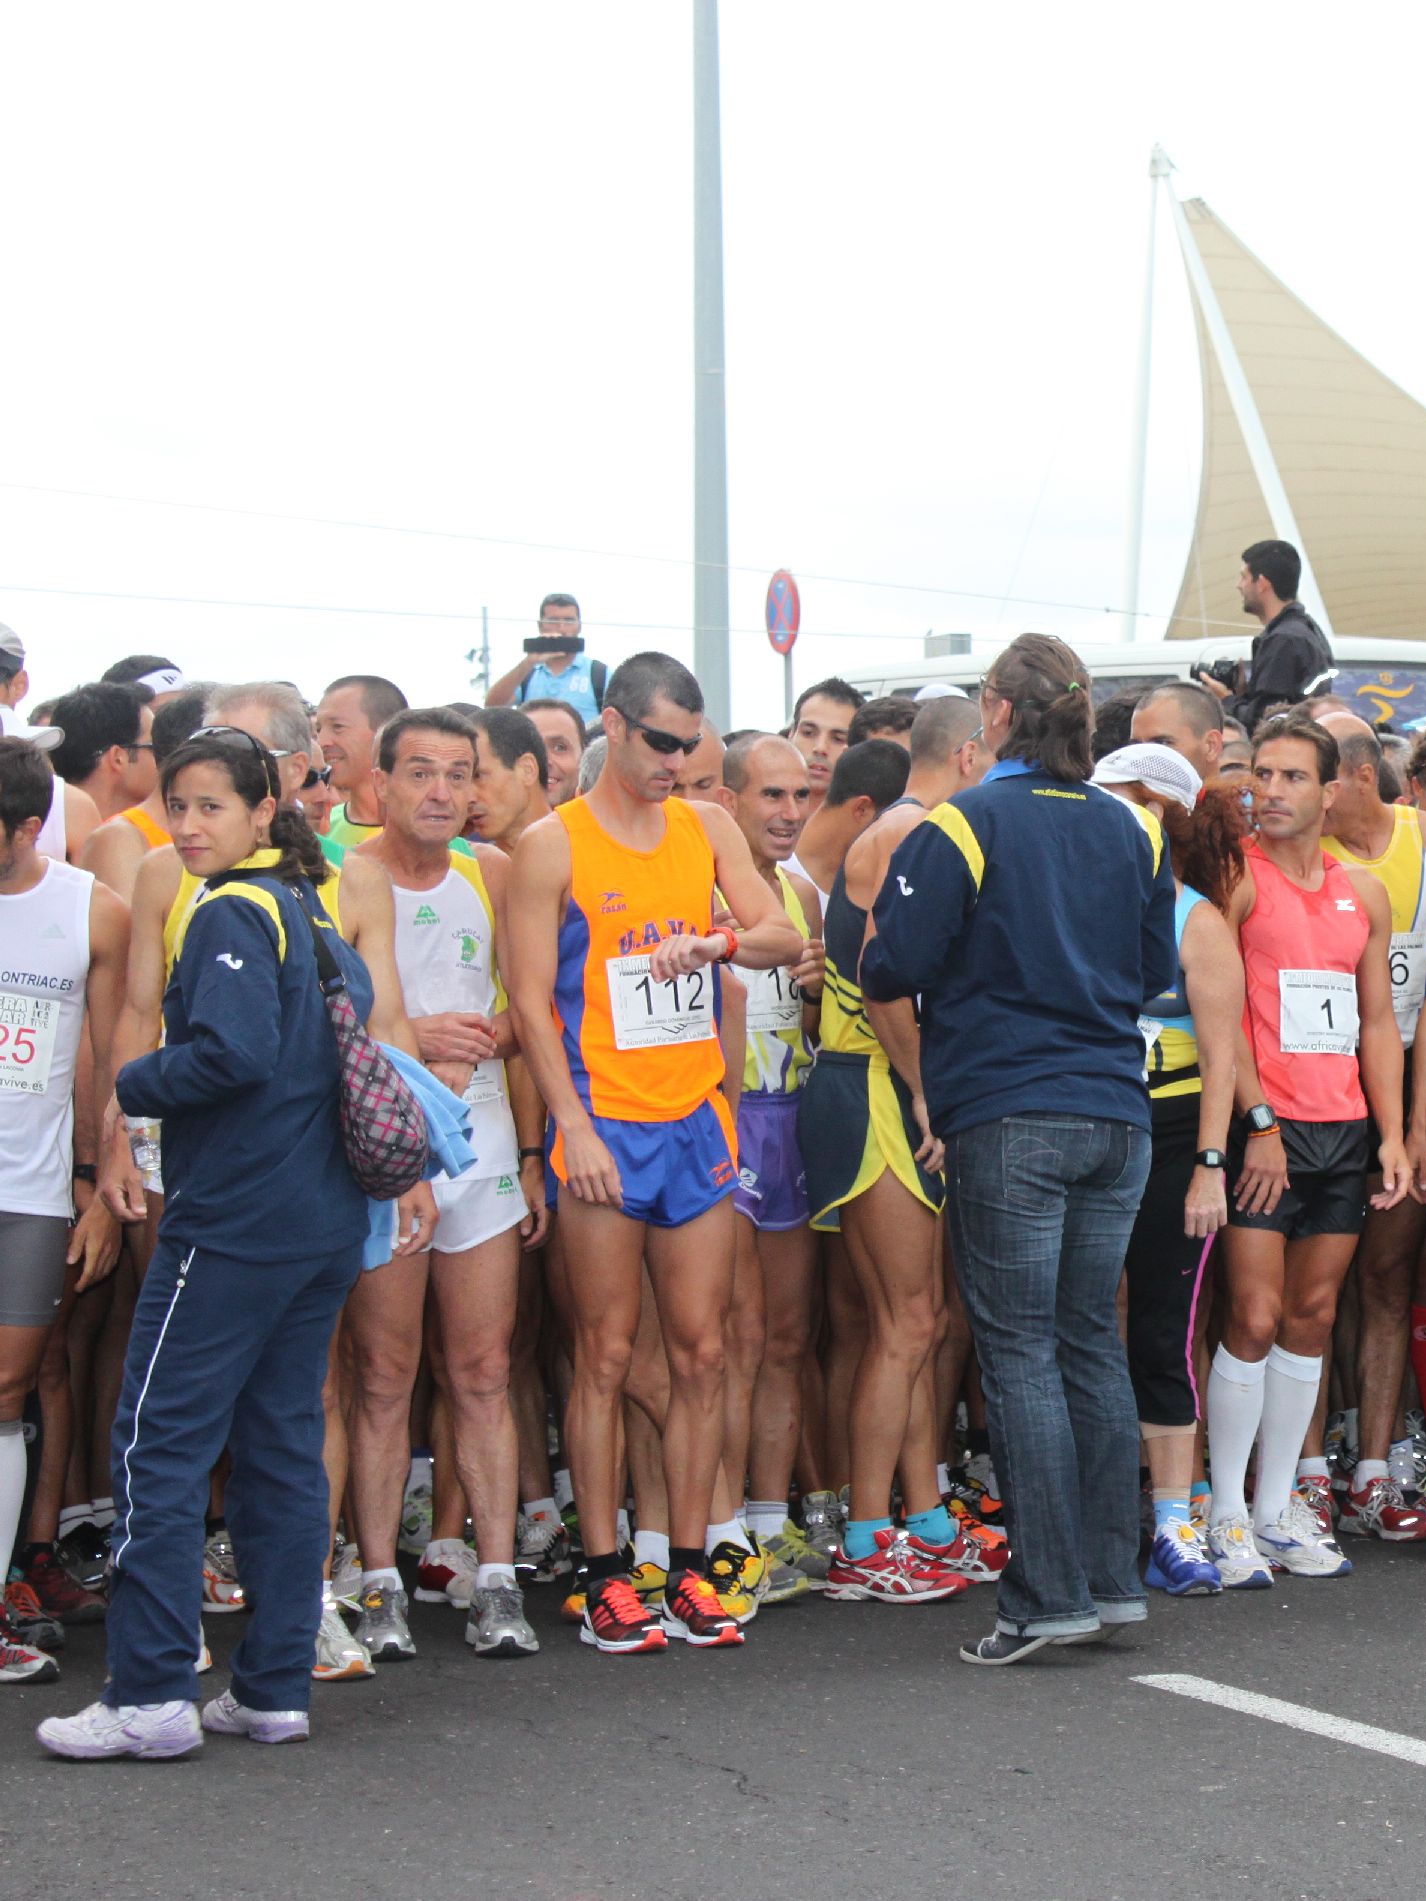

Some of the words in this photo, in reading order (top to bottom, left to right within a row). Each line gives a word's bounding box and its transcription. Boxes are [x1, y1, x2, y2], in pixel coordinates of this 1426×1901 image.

[619, 919, 698, 955] U.A.V
[635, 971, 705, 1015] 112
[1321, 998, 1334, 1029] 1
